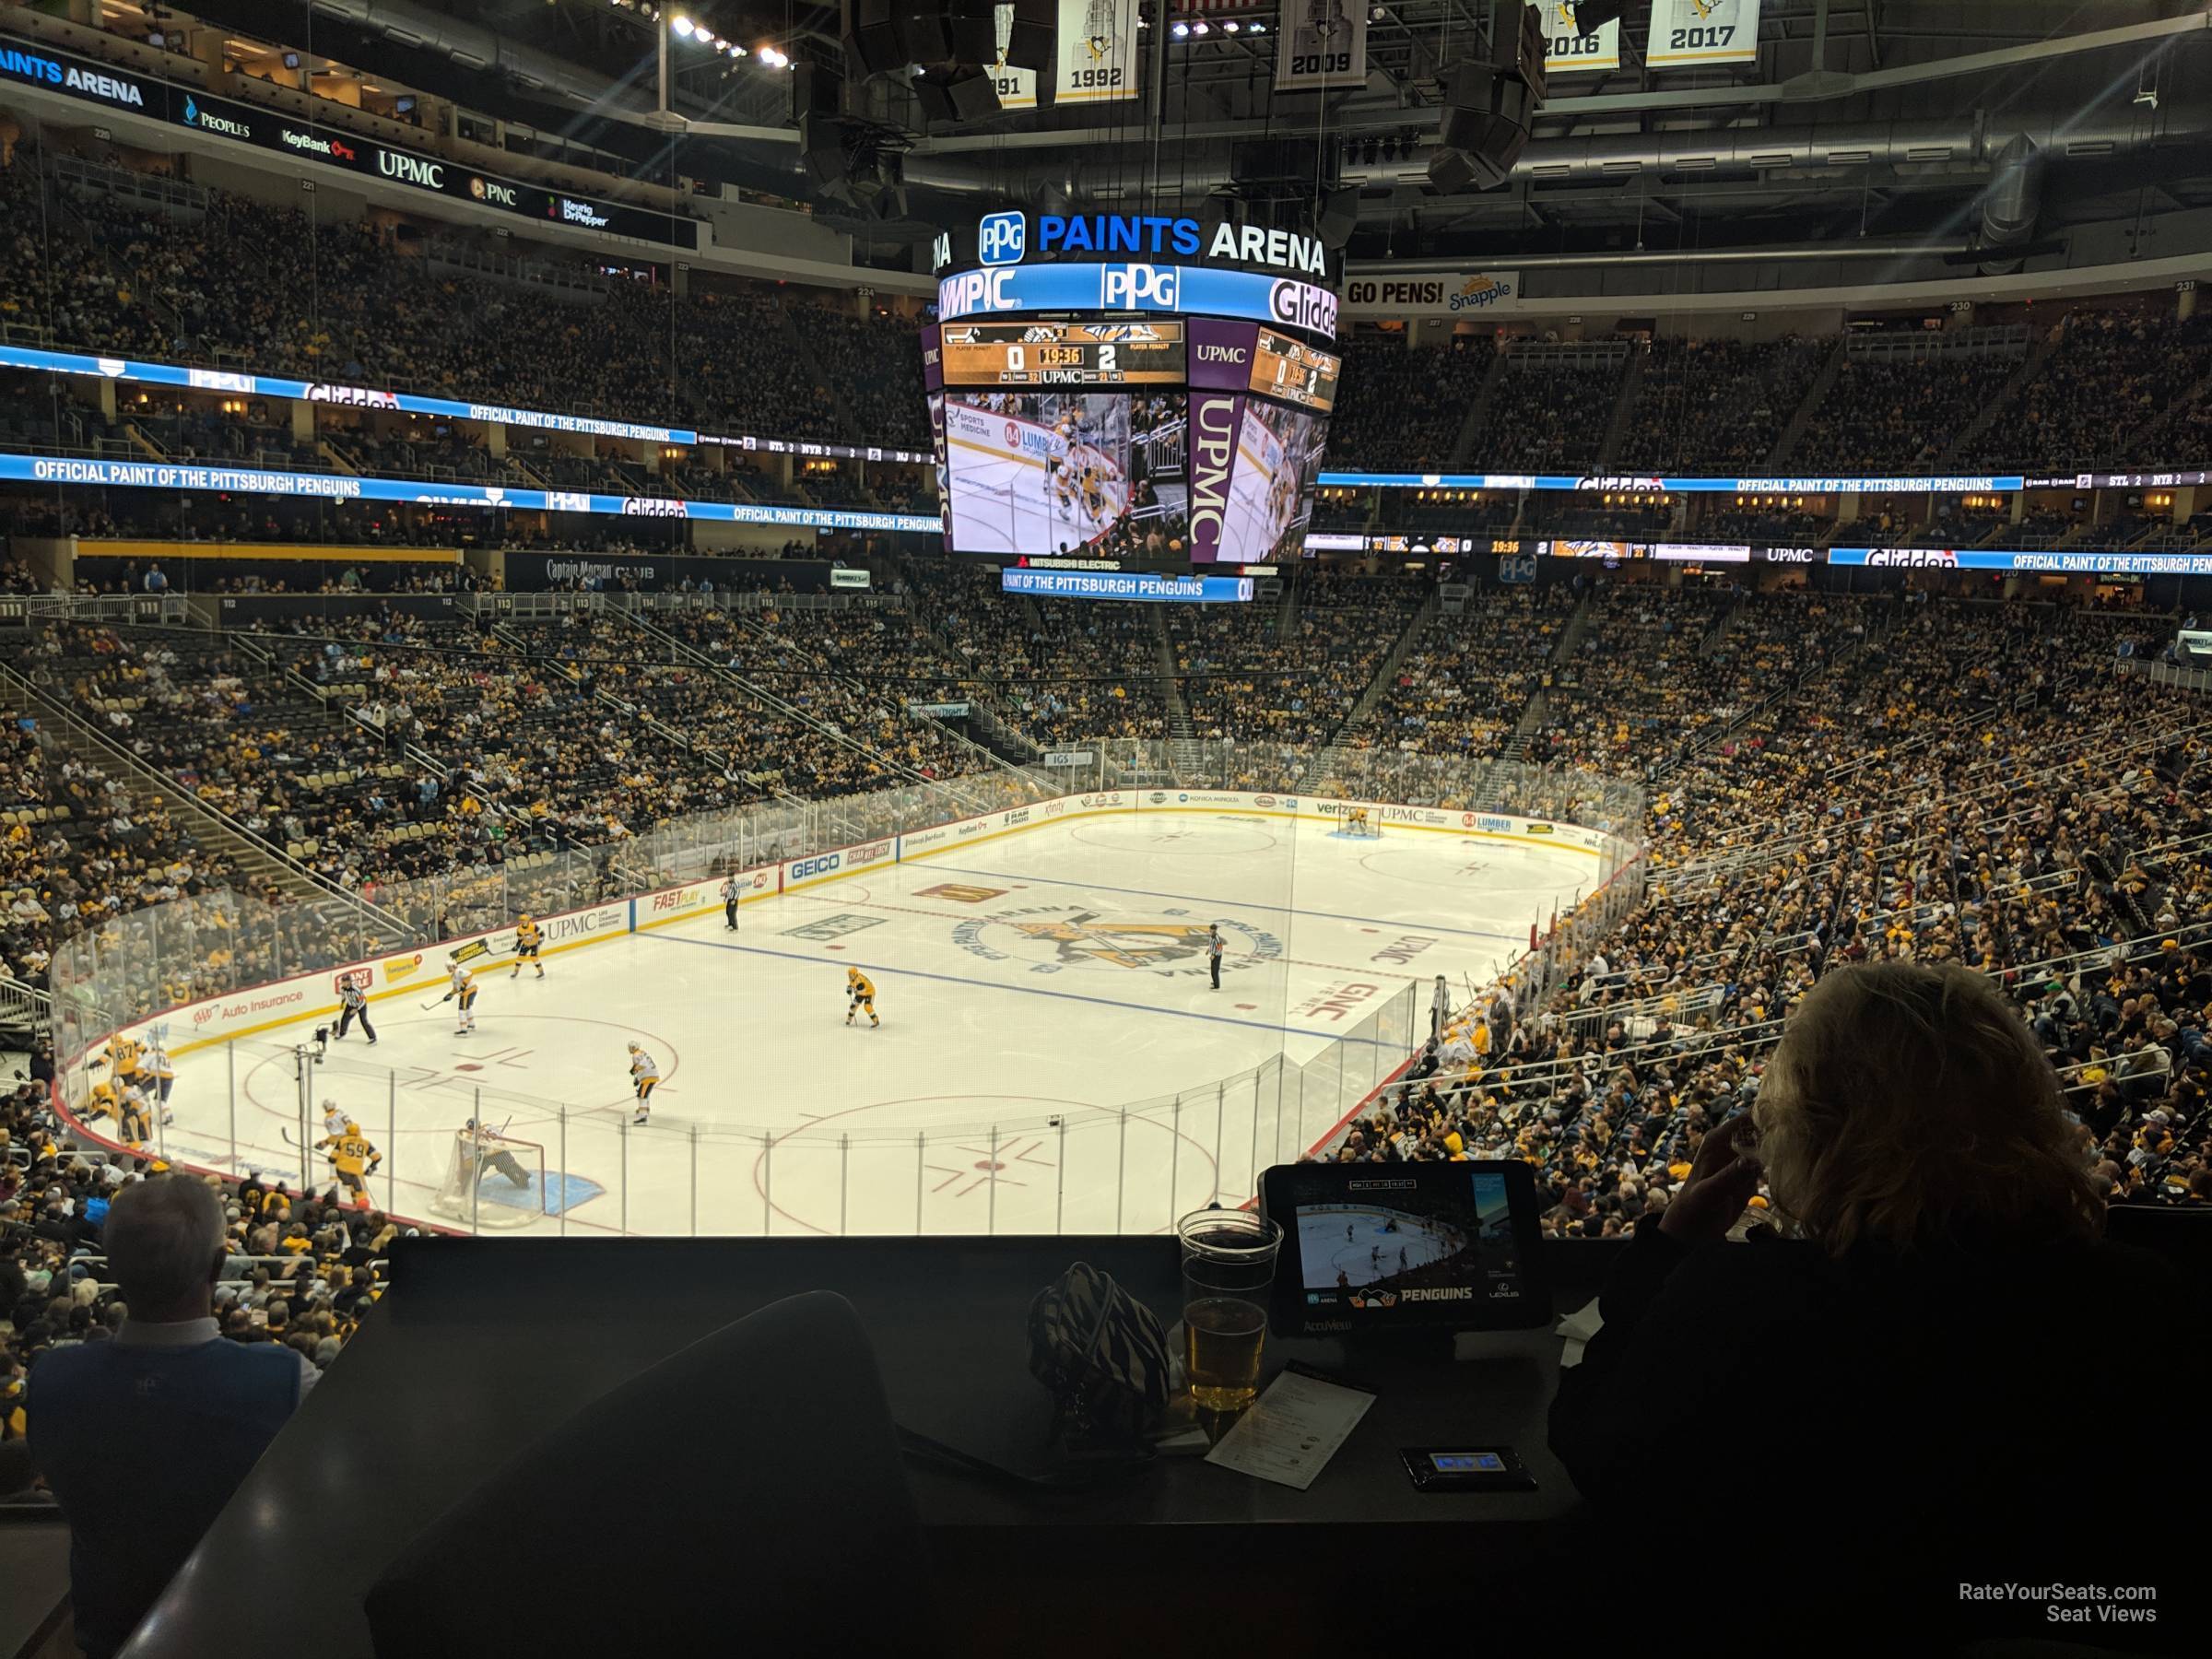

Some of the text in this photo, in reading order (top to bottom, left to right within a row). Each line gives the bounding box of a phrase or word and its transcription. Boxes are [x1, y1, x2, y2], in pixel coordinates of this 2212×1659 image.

[1545, 34, 1600, 56] 2016
[1670, 26, 1735, 49] 2017
[1291, 53, 1350, 74] 2009
[1071, 68, 1122, 88] 1992
[66, 67, 144, 107] ARENA
[282, 129, 331, 155] KeyBank
[378, 150, 443, 189] UPMC
[486, 182, 517, 206] PNC
[562, 199, 594, 217] Keurig
[1040, 216, 1201, 255] PAINTS
[1208, 222, 1326, 276] ARENA
[857, 287, 875, 296] 224
[1348, 282, 1443, 303] GO PENS!
[2176, 281, 2194, 291] 231
[1450, 281, 1512, 311] Snapple
[1951, 301, 1971, 311] 230
[924, 348, 939, 366] UPMC
[1007, 346, 1024, 370] 0
[1043, 349, 1079, 363] 19:36
[1099, 345, 1116, 371] 2
[1197, 345, 1246, 363] UPMC
[1029, 372, 1038, 381] 32
[1043, 371, 1081, 382] UPMC
[1308, 371, 1318, 394] 2
[470, 406, 669, 441] OFFICIAL PAINT OF THE PITTSBURGH PENGUINS
[960, 415, 984, 426] SPORTS
[961, 423, 991, 437] MEDICINE
[1006, 426, 1019, 444] 84
[769, 441, 855, 457] STL 2 NYR 2 2
[897, 452, 908, 461] NJ
[35, 460, 360, 496] OFFICIAL PAINT OF THE PITTSBURGH PENGUINS
[1190, 396, 1234, 546] UPMC
[2110, 473, 2204, 486] STL 2 NYR 2 2
[1737, 478, 1993, 491] OFFICIAL PAINT OF THE PITTSBURGH PENGUINS
[735, 508, 944, 532] OFFICIAL PAINT OF THE PITTSBURGH PENGUINS
[1374, 541, 1382, 550] 32
[1463, 540, 1471, 551] 0
[1491, 541, 1519, 553] 19:36
[1538, 542, 1547, 553] 2
[1634, 549, 1643, 558] 21
[1768, 548, 1813, 561] UPMC
[2014, 555, 2060, 570] OFFICIAL
[2063, 556, 2094, 570] PAINT
[2097, 557, 2111, 571] OF
[2112, 557, 2130, 571] THE
[2132, 558, 2190, 571] PITTSBURGH
[1030, 559, 1120, 570] MITSUBISHI ELECTRIC
[547, 559, 577, 588] Captain
[1023, 576, 1032, 589] OF
[1033, 576, 1053, 590] THE
[1056, 577, 1135, 594] PITTSBURGH
[1139, 580, 1203, 595] PENGUINS
[141, 602, 158, 614] 111
[224, 598, 236, 608] 112
[498, 599, 512, 609] 113
[577, 599, 589, 608] 113
[642, 599, 654, 607] 114
[1053, 754, 1069, 764] IGS
[1011, 809, 1029, 818] RAM
[1011, 817, 1029, 825] 1500
[1382, 806, 1424, 821] UPMC
[1477, 818, 1511, 829] LUMBER
[792, 854, 840, 879] GEICO
[653, 890, 682, 911] FAST
[682, 889, 700, 903] PLAY
[547, 912, 597, 940] UPMC
[1371, 935, 1439, 965] UPMC
[222, 991, 303, 1019] Auto Insurance
[1305, 983, 1379, 1021] GNC
[117, 1044, 133, 1062] 87
[346, 1142, 364, 1159] 59
[1401, 1288, 1473, 1301] PENGUINS
